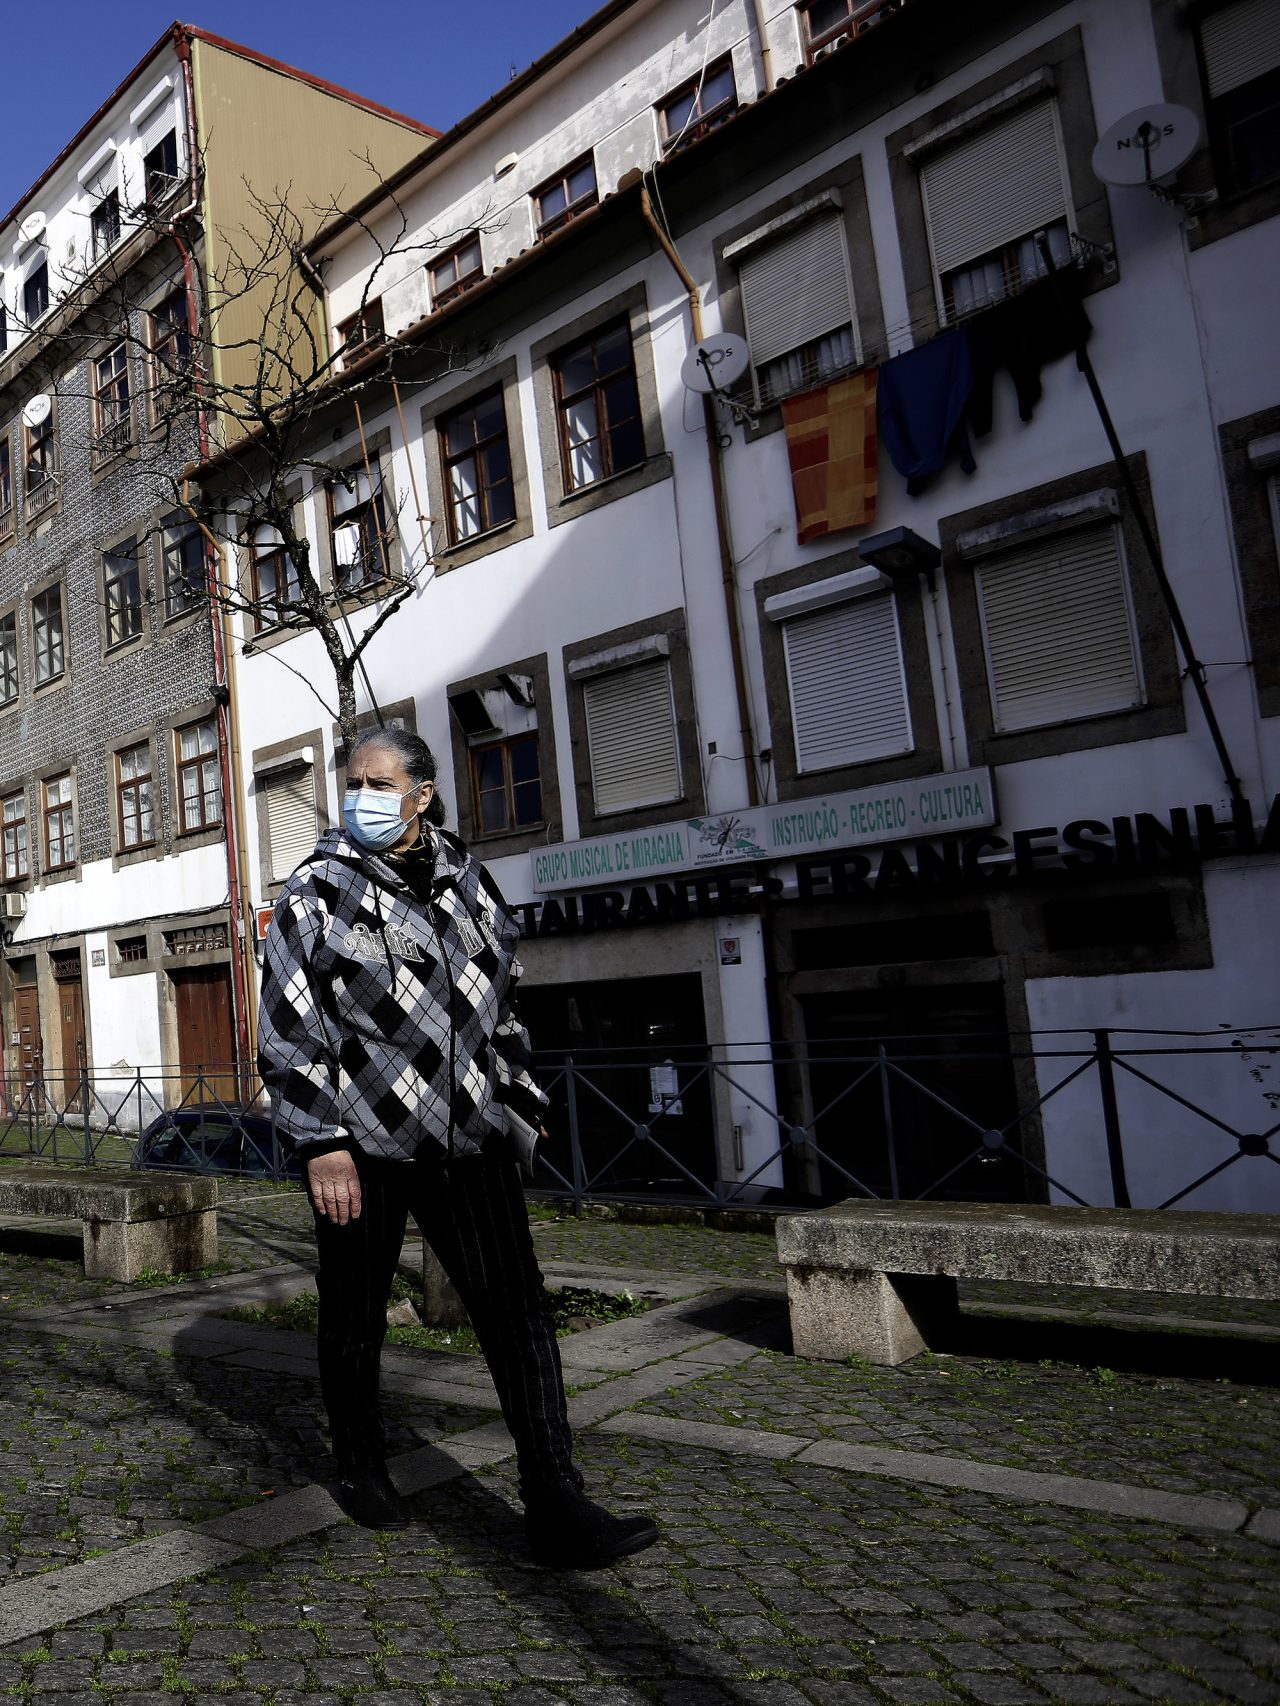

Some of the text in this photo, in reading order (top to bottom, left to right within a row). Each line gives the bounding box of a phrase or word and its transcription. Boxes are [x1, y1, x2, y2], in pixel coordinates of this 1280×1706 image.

[772, 800, 838, 847] INSTRUÇÃO
[849, 796, 906, 835] RECREIO
[919, 783, 984, 825] CULTURA
[535, 831, 684, 884] GRUPO MUSICAL DE MIRAGAIA
[507, 871, 755, 938] TAURANTE
